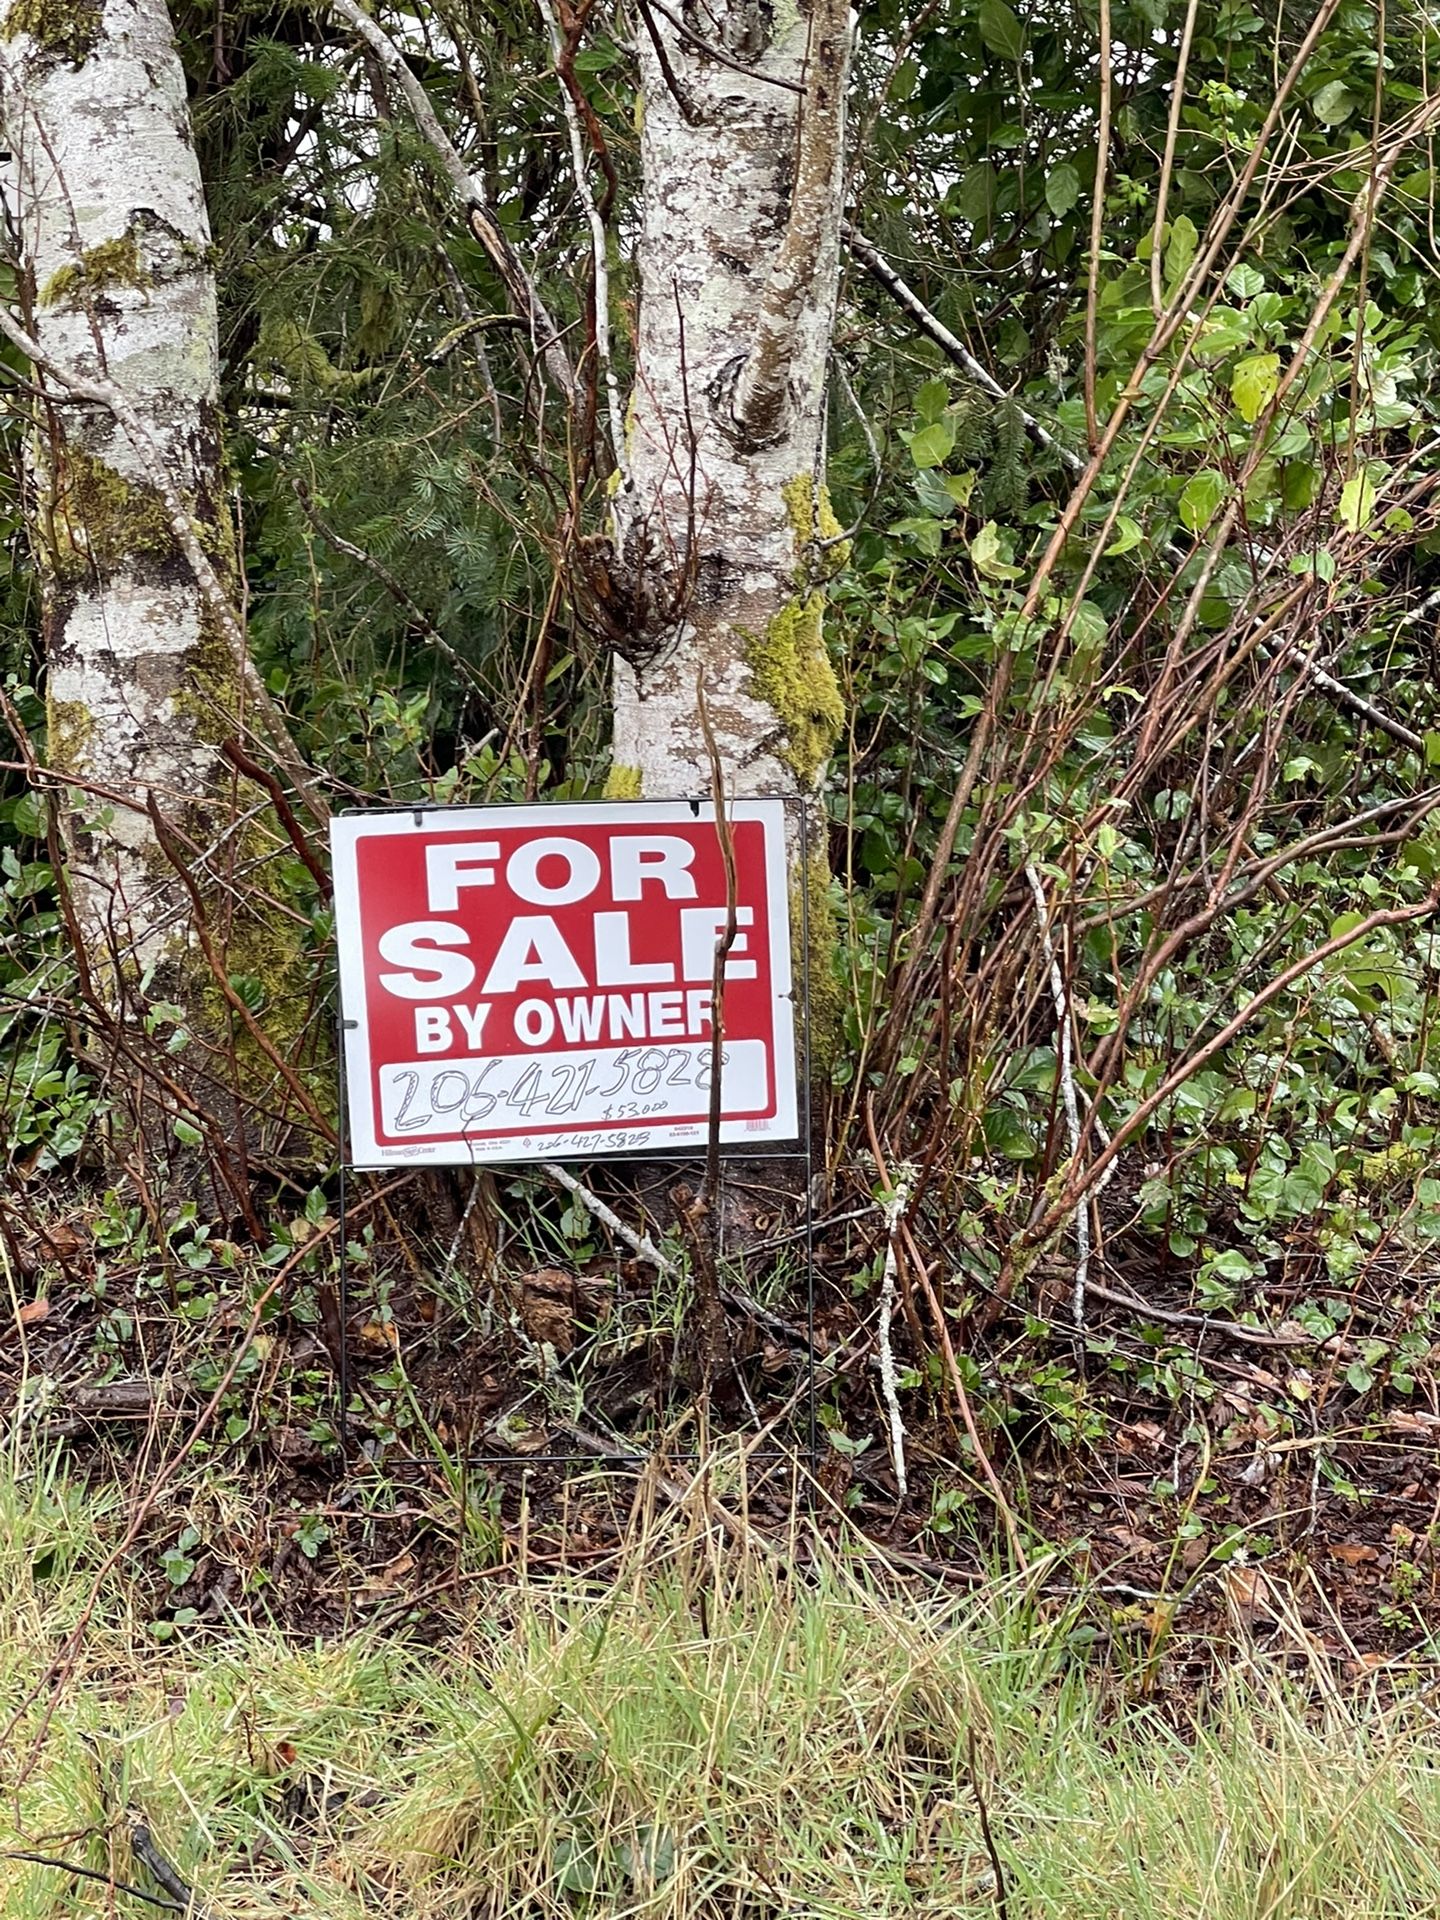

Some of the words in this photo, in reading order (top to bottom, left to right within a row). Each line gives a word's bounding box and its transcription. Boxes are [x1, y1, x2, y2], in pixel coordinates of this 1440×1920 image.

[425, 835, 699, 912] FOR
[377, 905, 758, 1000] SALE
[414, 1003, 492, 1054] BY
[513, 990, 726, 1047] OWNER
